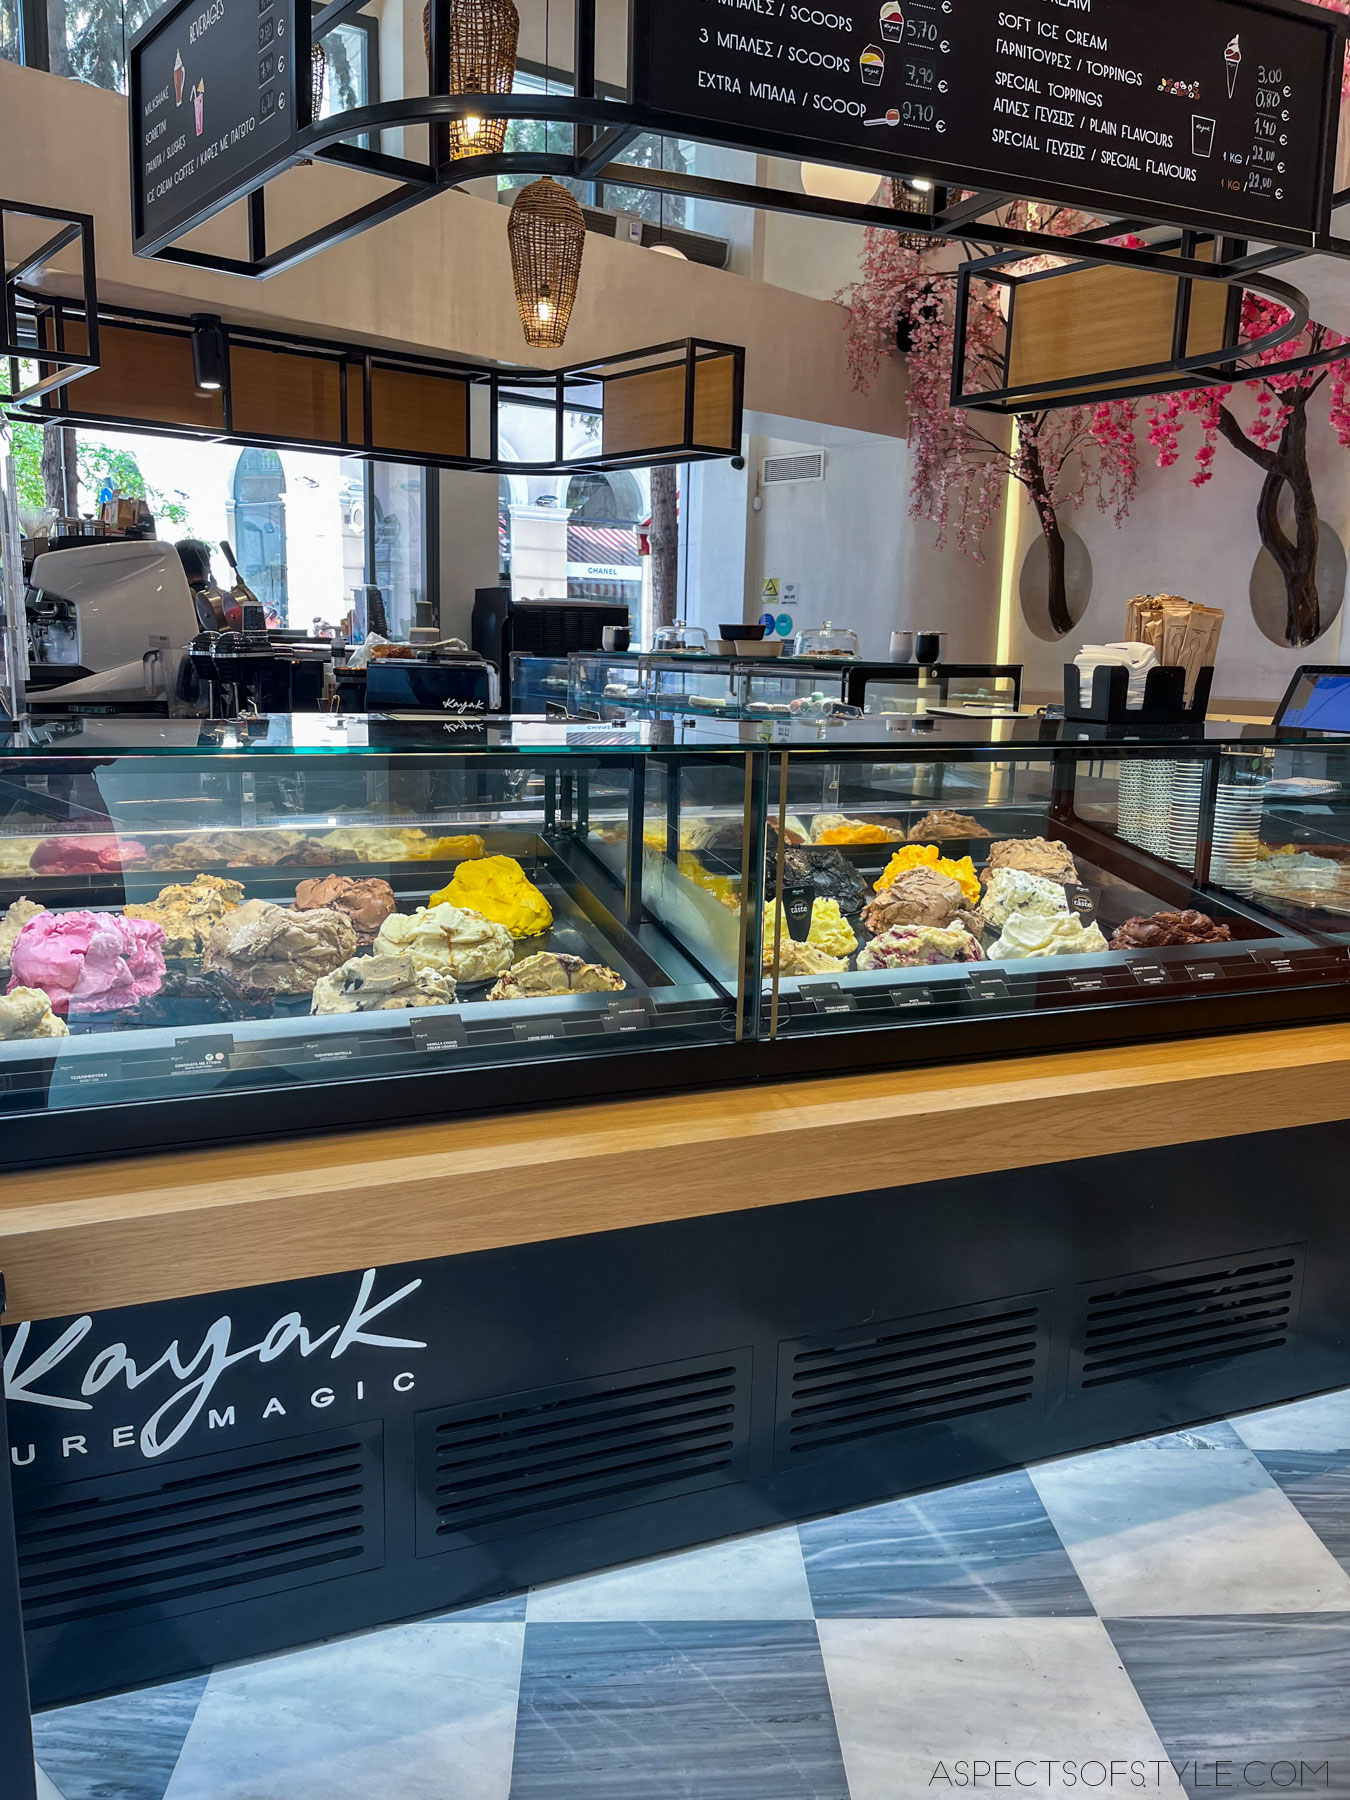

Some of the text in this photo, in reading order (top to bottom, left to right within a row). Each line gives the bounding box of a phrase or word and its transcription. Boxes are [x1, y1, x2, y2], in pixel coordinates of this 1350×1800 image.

[190, 0, 224, 44] BEVERAGES
[717, 0, 852, 32] ΑΛΕΣ / SCOOPS
[1042, 0, 1090, 12] EAM
[278, 19, 284, 36] €
[906, 19, 950, 53] 5,70 €
[998, 12, 1108, 51] SOFT ICE CREAM
[278, 56, 284, 72] €
[698, 28, 850, 73] 3 ΜΠΑΛΕΣ / SCOOPS
[996, 38, 1143, 86] ΓΑΡΝΙΤΟΥΡΕΣ / TOPPINGS
[698, 70, 867, 118] EXTRA ΜΠΑΛΑ / SCOOP
[905, 64, 948, 93] 7,90 €
[995, 71, 1103, 107] SPECIAL TOPPINGS
[1258, 65, 1292, 97] 3,00 €
[145, 85, 169, 117] MILKSHAKE
[278, 92, 285, 109] €
[1255, 91, 1290, 121] 0,80 €
[903, 101, 946, 133] 2,70 €
[993, 97, 1173, 148] ΑΠΛΕΣ ΓΕΥΣΕΙΣ / PLAIN FLAVOURS
[1254, 117, 1288, 146] 1,40 €
[147, 189, 155, 205] ICE
[157, 177, 173, 197] CREAM
[174, 159, 195, 185] COFFEE
[231, 117, 256, 145] ΠΑΓΩΤΟ
[991, 129, 1197, 182] SPECIAL ΓΕΥΣΕΙΣ / SPECIAL FLAVOURS
[1230, 152, 1243, 164] KG
[1245, 154, 1250, 165] /
[1277, 162, 1286, 173] €
[1227, 179, 1240, 191] KG
[1243, 181, 1248, 192] /
[1275, 188, 1283, 199] €
[588, 567, 618, 576] CHANEL
[443, 698, 484, 714] Kayak
[3, 1268, 428, 1458] Kayak
[11, 1372, 415, 1466] URE MAGIC
